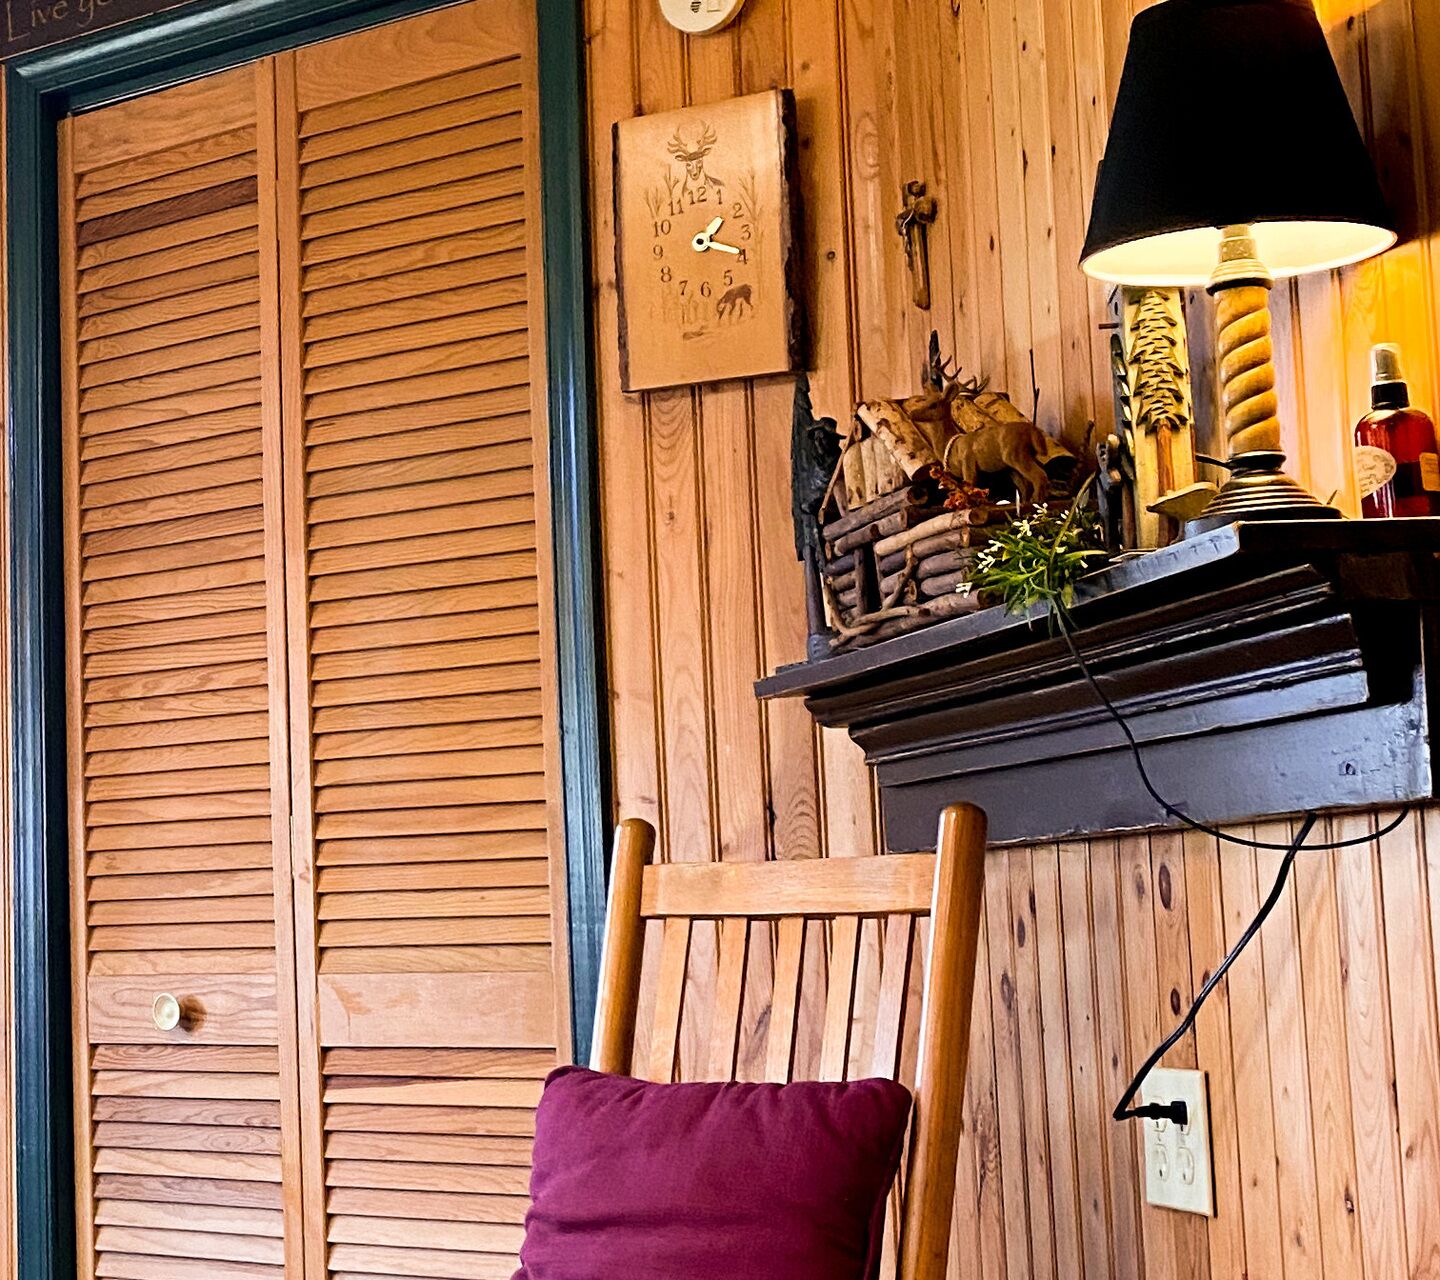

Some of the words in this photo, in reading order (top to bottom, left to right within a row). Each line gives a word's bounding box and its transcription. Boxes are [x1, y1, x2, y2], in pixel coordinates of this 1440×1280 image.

[6, 0, 68, 42] Live
[687, 186, 707, 205] 12
[716, 188, 723, 205] 1
[668, 198, 684, 216] 11
[732, 202, 744, 219] 2
[653, 219, 671, 238] 10
[741, 224, 751, 241] 3
[653, 244, 663, 261] 9
[660, 265, 672, 283] 8
[723, 269, 733, 287] 5
[679, 280, 688, 296] 7
[700, 281, 711, 298] 6
